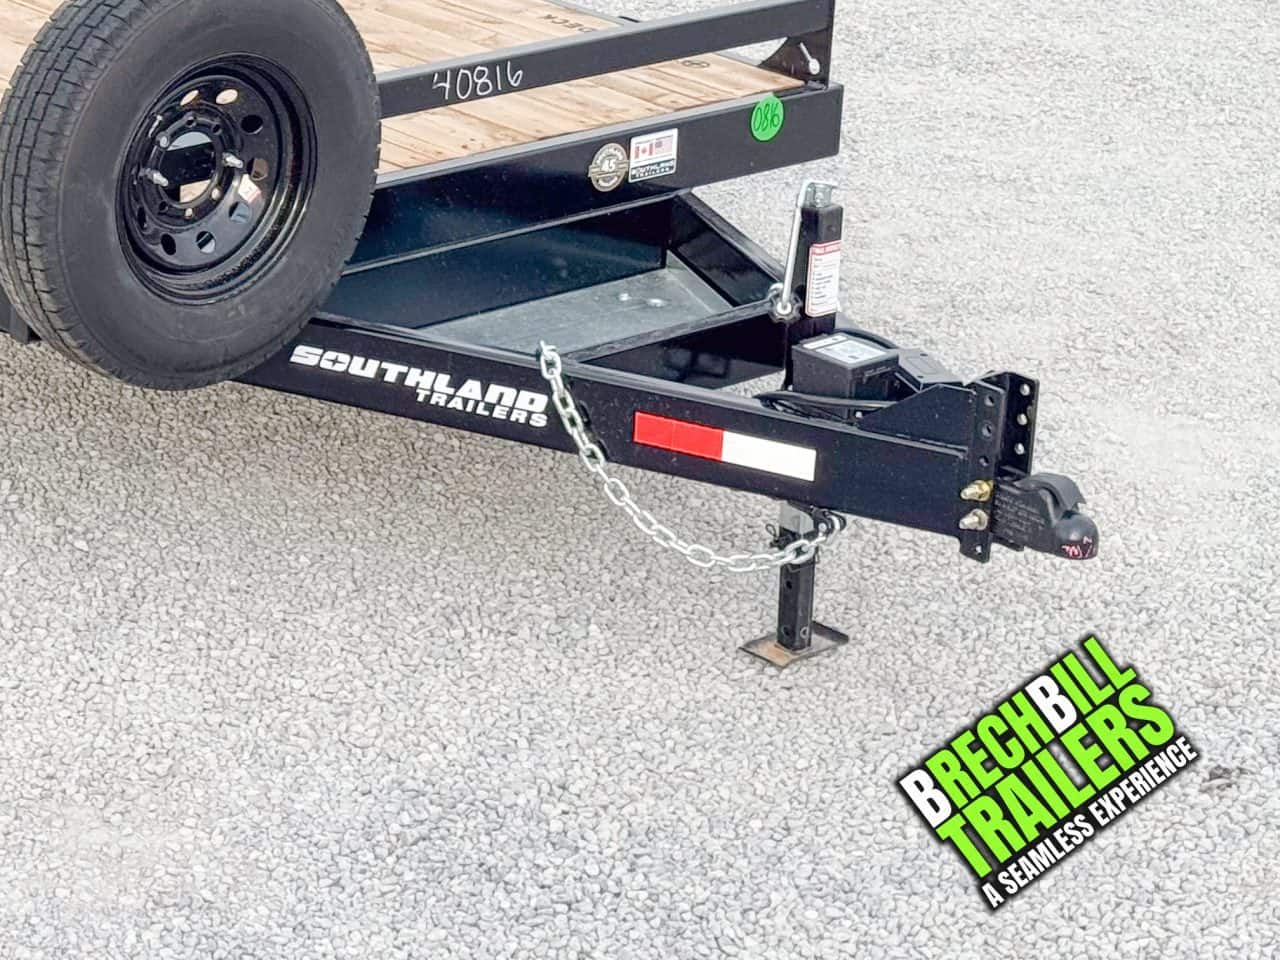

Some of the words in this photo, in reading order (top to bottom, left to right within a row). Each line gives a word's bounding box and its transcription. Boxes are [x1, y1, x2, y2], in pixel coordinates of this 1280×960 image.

[432, 60, 523, 100] 40816
[289, 345, 549, 413] SOUTHLAND
[416, 388, 549, 428] TRAILERS
